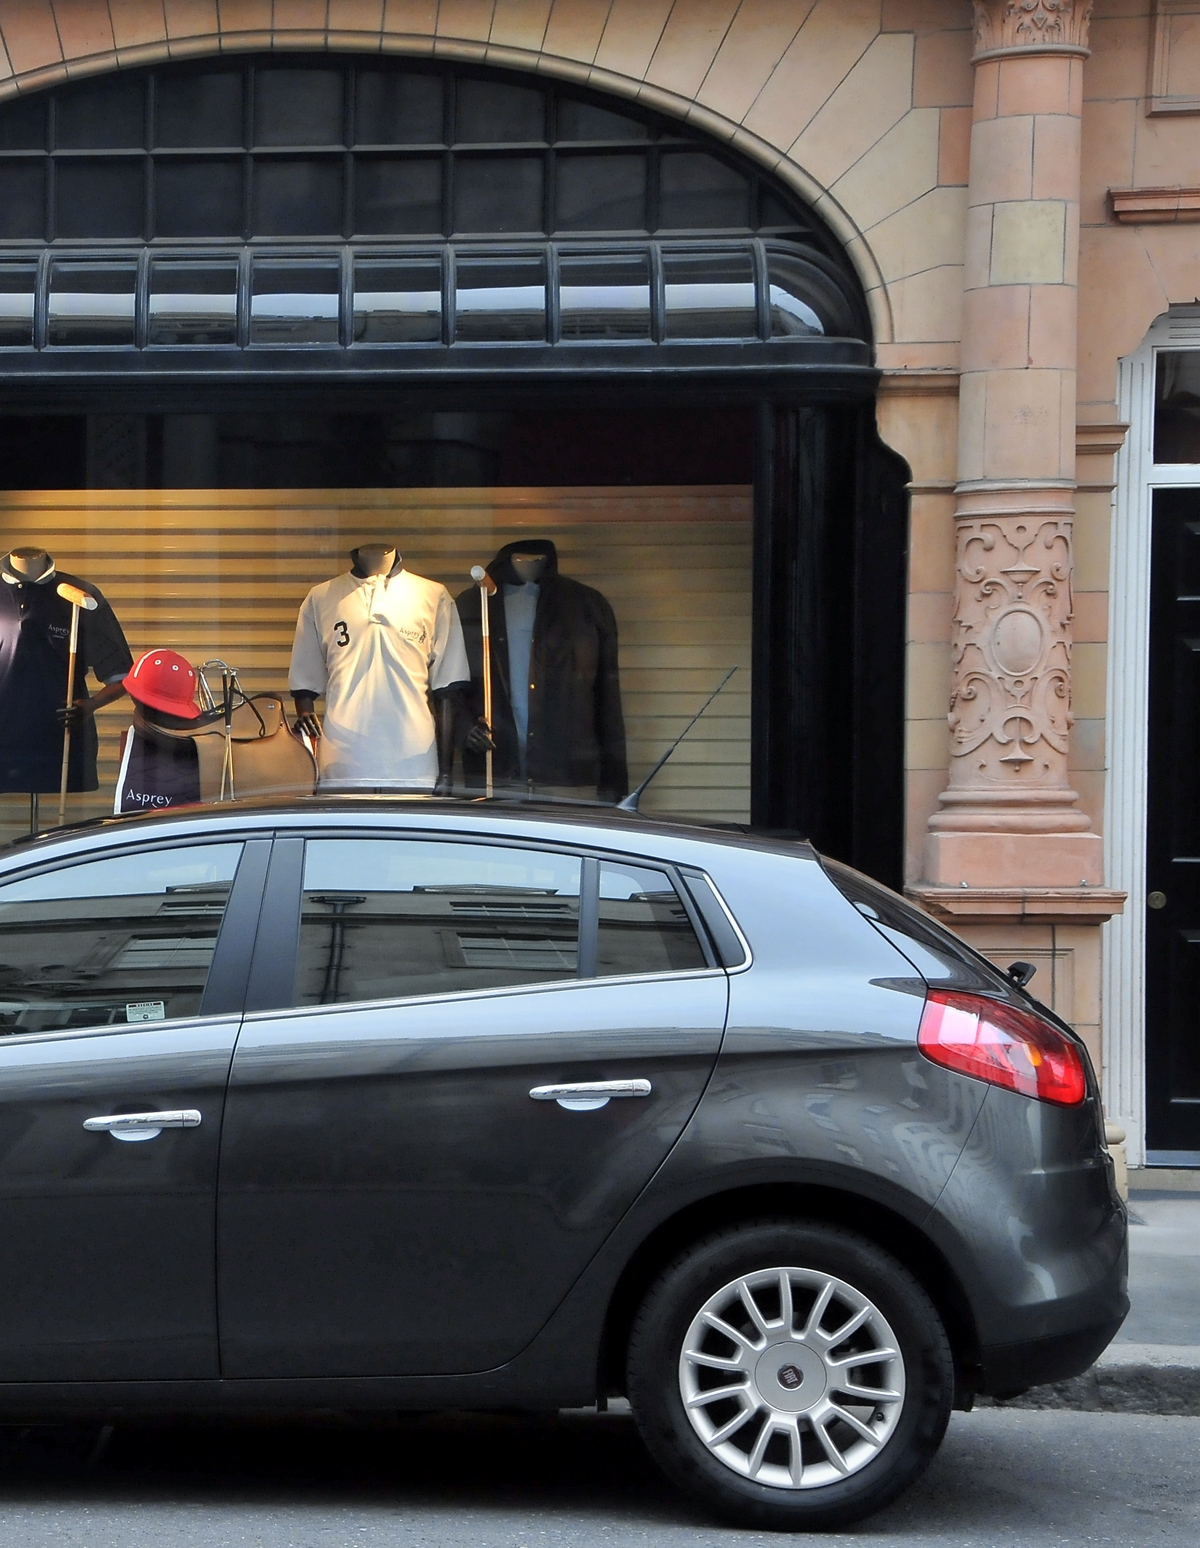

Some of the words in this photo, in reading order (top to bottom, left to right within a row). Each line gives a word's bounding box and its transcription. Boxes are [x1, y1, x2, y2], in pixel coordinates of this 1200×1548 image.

[333, 620, 350, 647] 3
[125, 788, 173, 808] Asprey
[782, 1368, 798, 1384] FIAT
